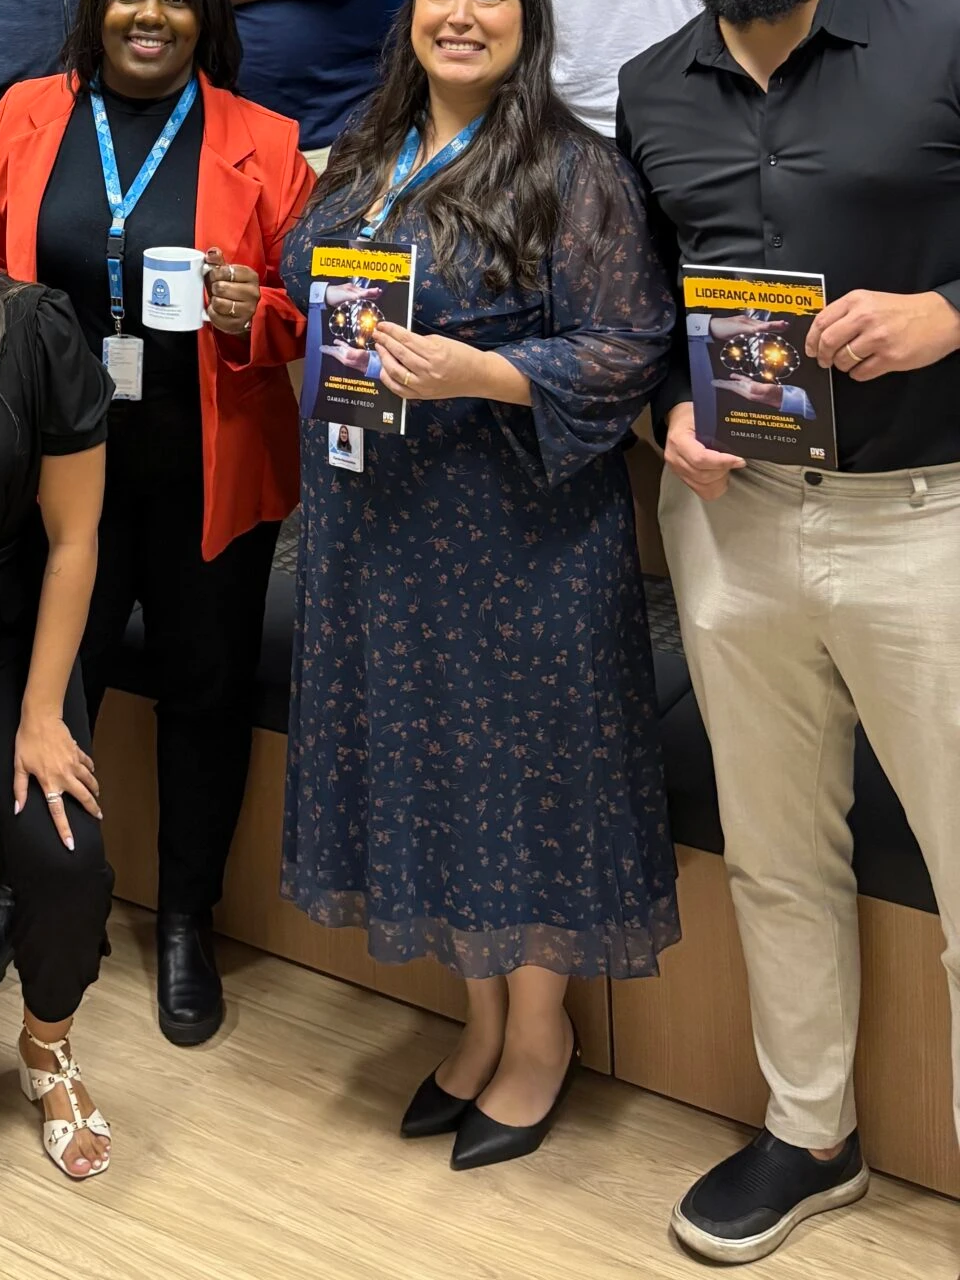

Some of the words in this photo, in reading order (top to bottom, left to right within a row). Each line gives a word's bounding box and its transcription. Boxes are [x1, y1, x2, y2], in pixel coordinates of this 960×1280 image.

[319, 257, 361, 271] LIDERANÇA
[362, 261, 388, 272] MODO
[389, 263, 402, 273] ON
[695, 287, 756, 303] LIDERANÇA
[758, 292, 793, 305] MODO
[795, 295, 812, 306] ON
[327, 395, 349, 404] DAMARIS
[350, 399, 375, 408] ALFREDO
[749, 413, 794, 422] TRANSFORMAR
[767, 422, 801, 430] LIDERANÇA
[730, 430, 762, 439] DAMARIS
[764, 434, 797, 444] ALFREDO
[810, 448, 825, 456] DVS
